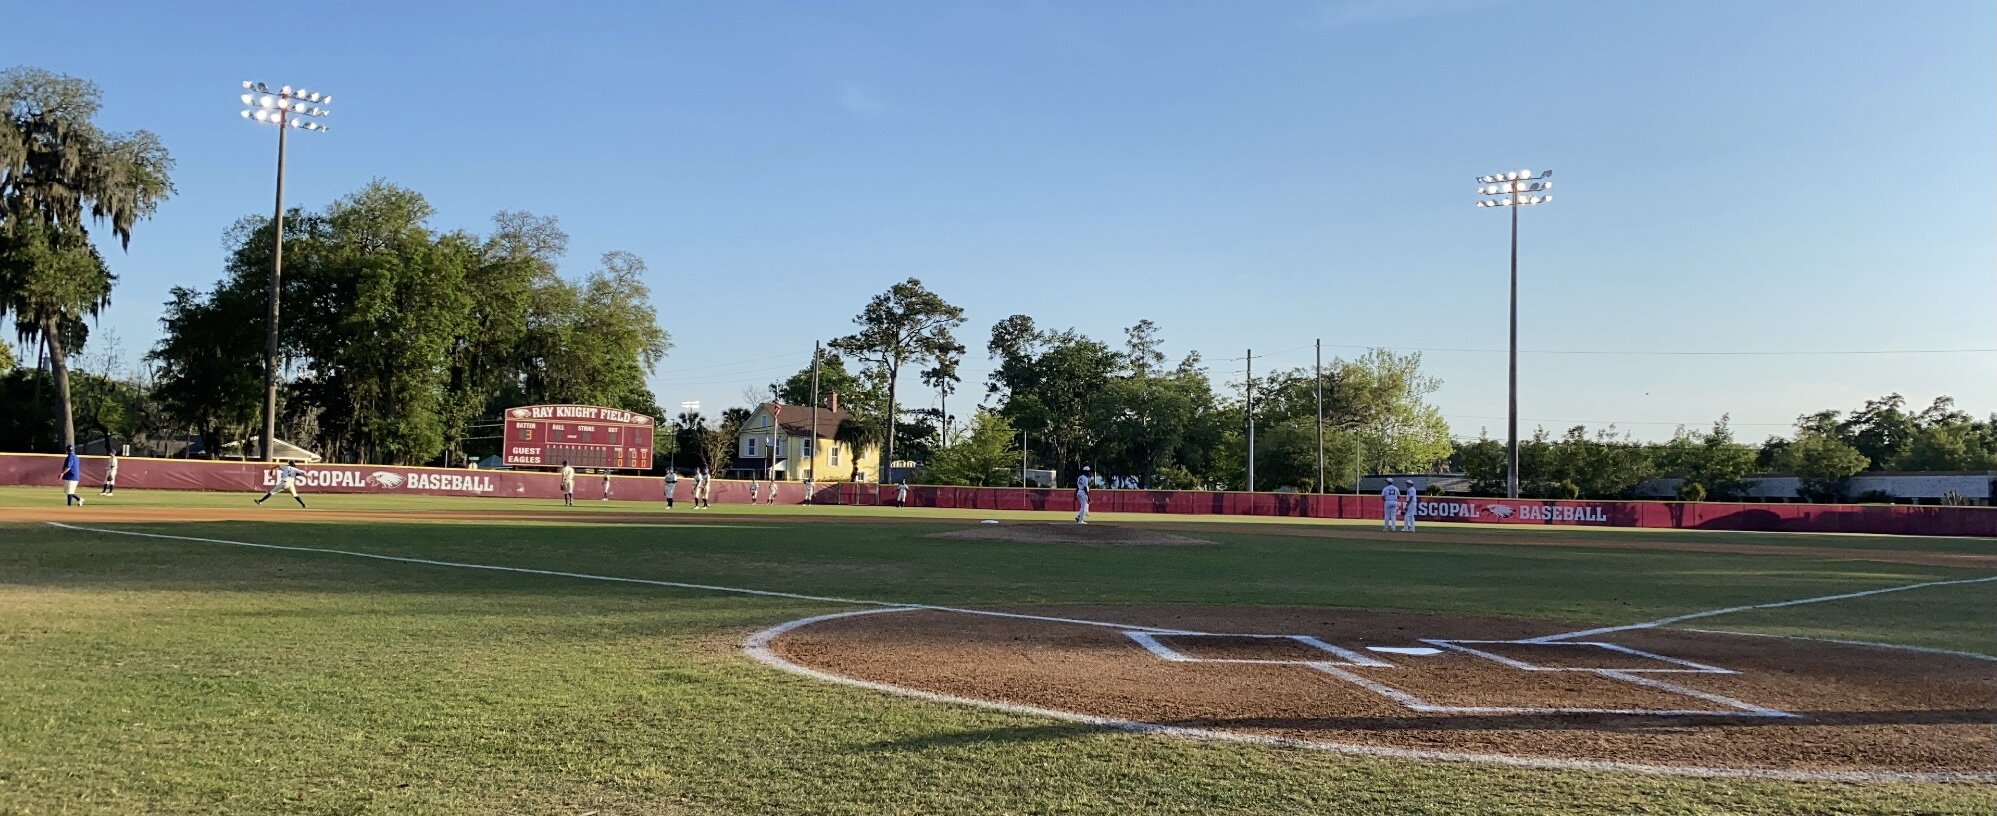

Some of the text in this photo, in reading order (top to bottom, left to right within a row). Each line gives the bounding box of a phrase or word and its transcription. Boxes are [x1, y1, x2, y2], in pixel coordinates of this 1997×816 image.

[532, 406, 631, 423] RAY KNIGHT FIELD
[508, 455, 541, 463] EAGLES
[512, 447, 541, 455] GUEST
[263, 469, 493, 491] ESCOPAL BASEBALL
[1396, 501, 1606, 521] SCOPAL BASEBALL
